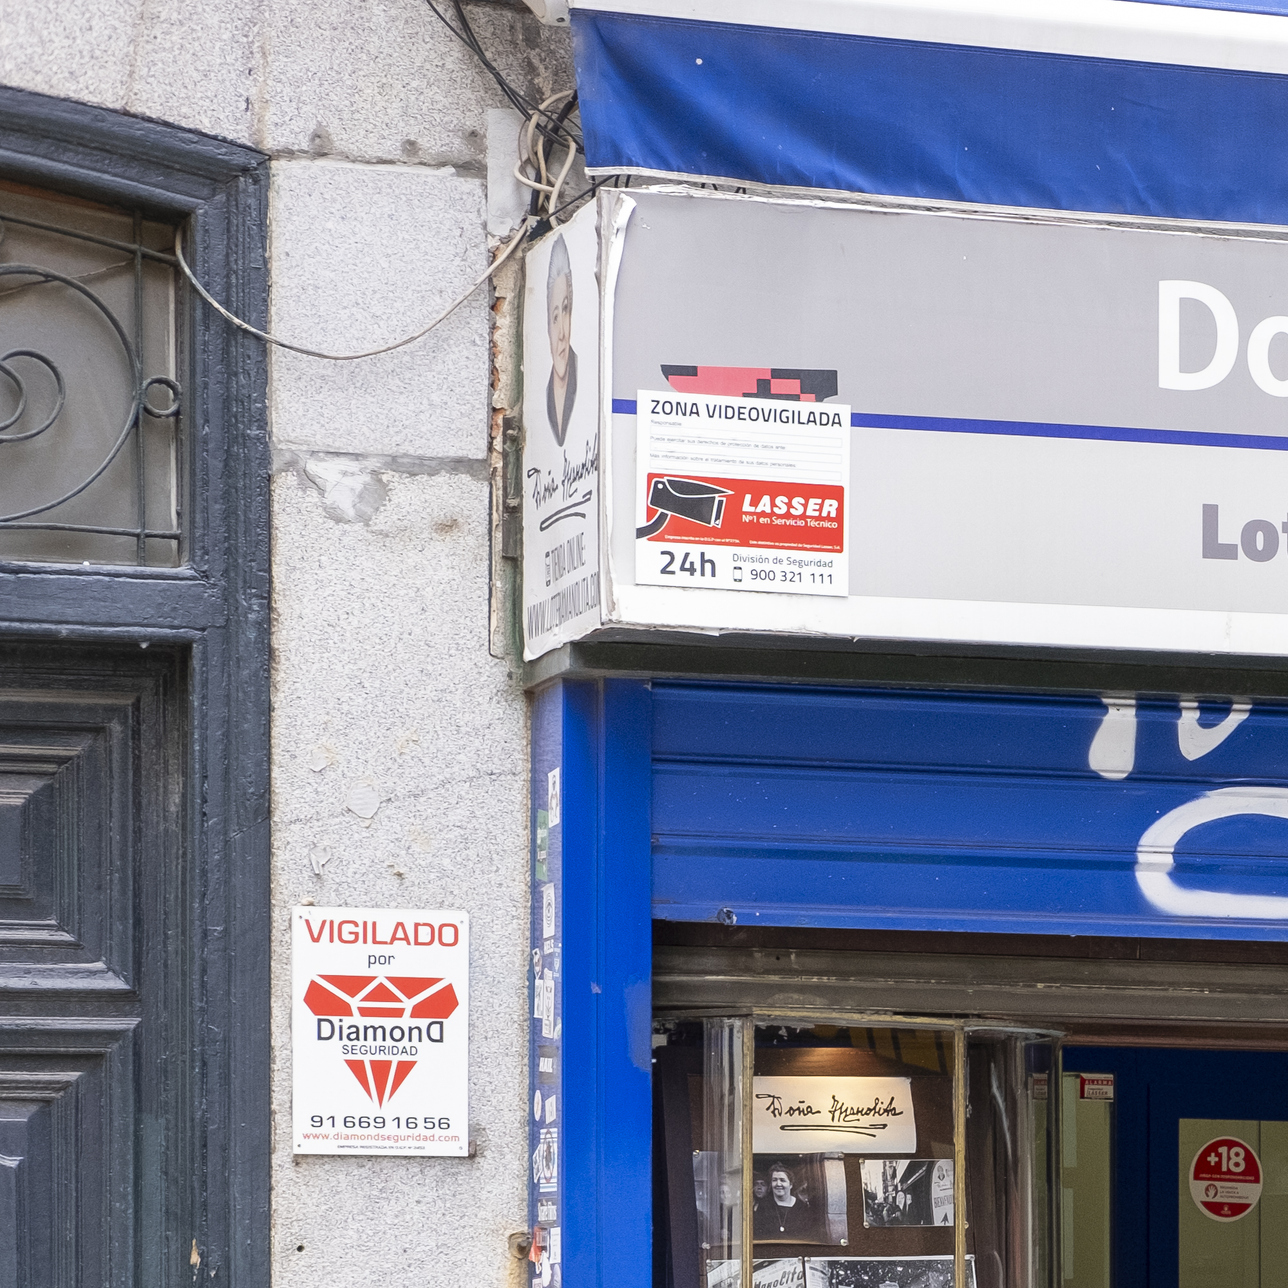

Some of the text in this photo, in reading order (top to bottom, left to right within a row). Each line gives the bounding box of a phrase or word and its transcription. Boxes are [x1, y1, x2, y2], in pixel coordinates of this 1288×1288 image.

[650, 399, 842, 428] ZONA VIDEOVIGILADA
[742, 493, 838, 518] LASSER
[759, 517, 771, 525] en
[772, 516, 805, 527] Servicio
[805, 517, 838, 529] Técnico
[659, 550, 717, 578] 24h
[733, 553, 834, 568] División de Seguridad
[750, 569, 833, 585] 900 321 111
[304, 919, 460, 947] VIGILADO
[367, 953, 396, 969] por
[341, 1044, 418, 1056] SEGURIDAD
[310, 1115, 451, 1130] 91 669 16 56
[302, 1131, 460, 1143] www.diamondseguridad.com
[1206, 1145, 1246, 1173] +18
